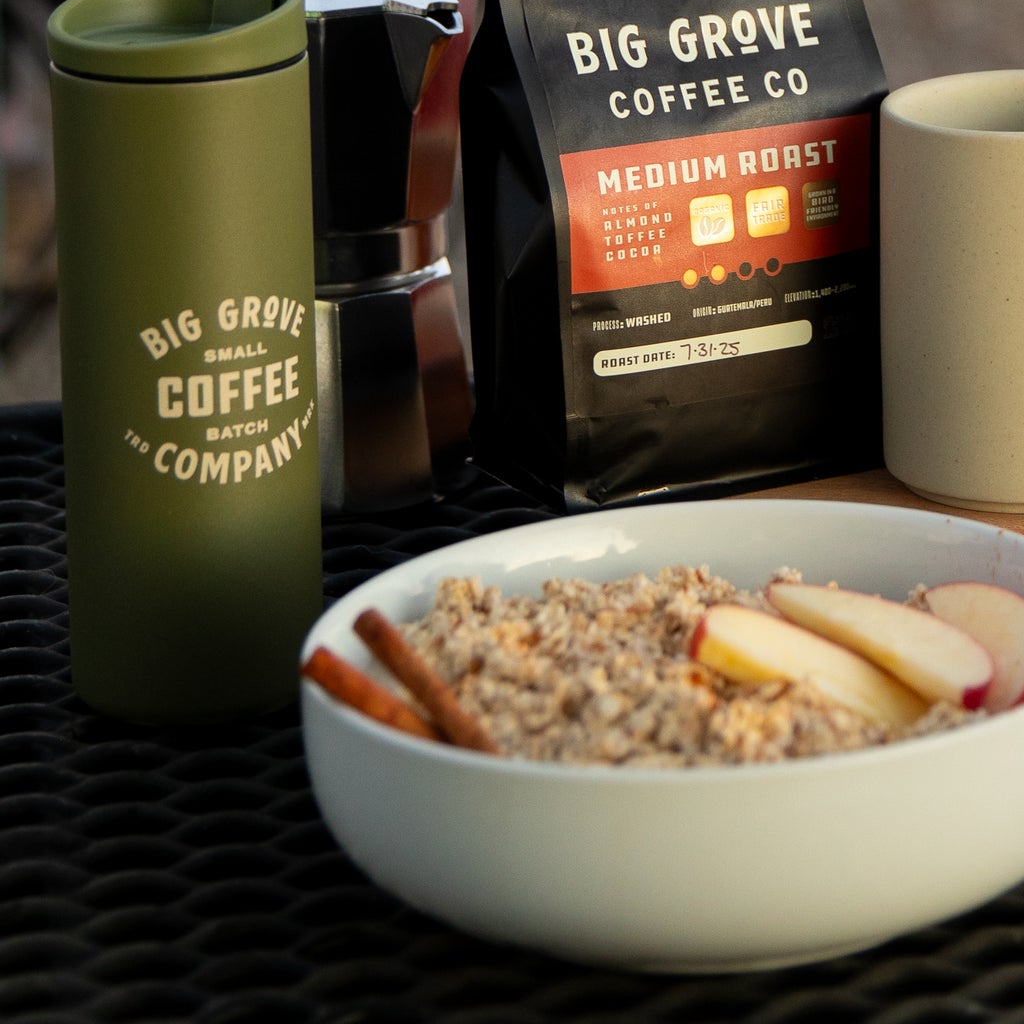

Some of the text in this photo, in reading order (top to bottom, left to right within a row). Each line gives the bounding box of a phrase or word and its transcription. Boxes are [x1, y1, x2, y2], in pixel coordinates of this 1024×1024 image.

[566, 2, 820, 75] BIG GROVE
[608, 67, 809, 119] COFFEE CO
[597, 139, 837, 195] MEDIUM ROAST
[602, 200, 659, 216] NOTES OF
[752, 198, 785, 212] FAIR
[811, 195, 834, 206] BIRD
[603, 211, 673, 231] ALMOND
[752, 211, 786, 225] TRADE
[604, 228, 667, 247] TOFFEE
[605, 244, 662, 262] COCOA
[717, 297, 773, 314] GUATEMALA/PERU
[139, 295, 306, 360] BIG GROVE
[592, 312, 672, 332] PROCESS: WASHED
[203, 341, 268, 363] SMALL
[601, 350, 676, 369] ROAST DATE:
[157, 355, 300, 418] COFFEE
[206, 418, 269, 441] BATCH
[124, 429, 150, 454] TRD
[153, 417, 303, 484] COMPANY
